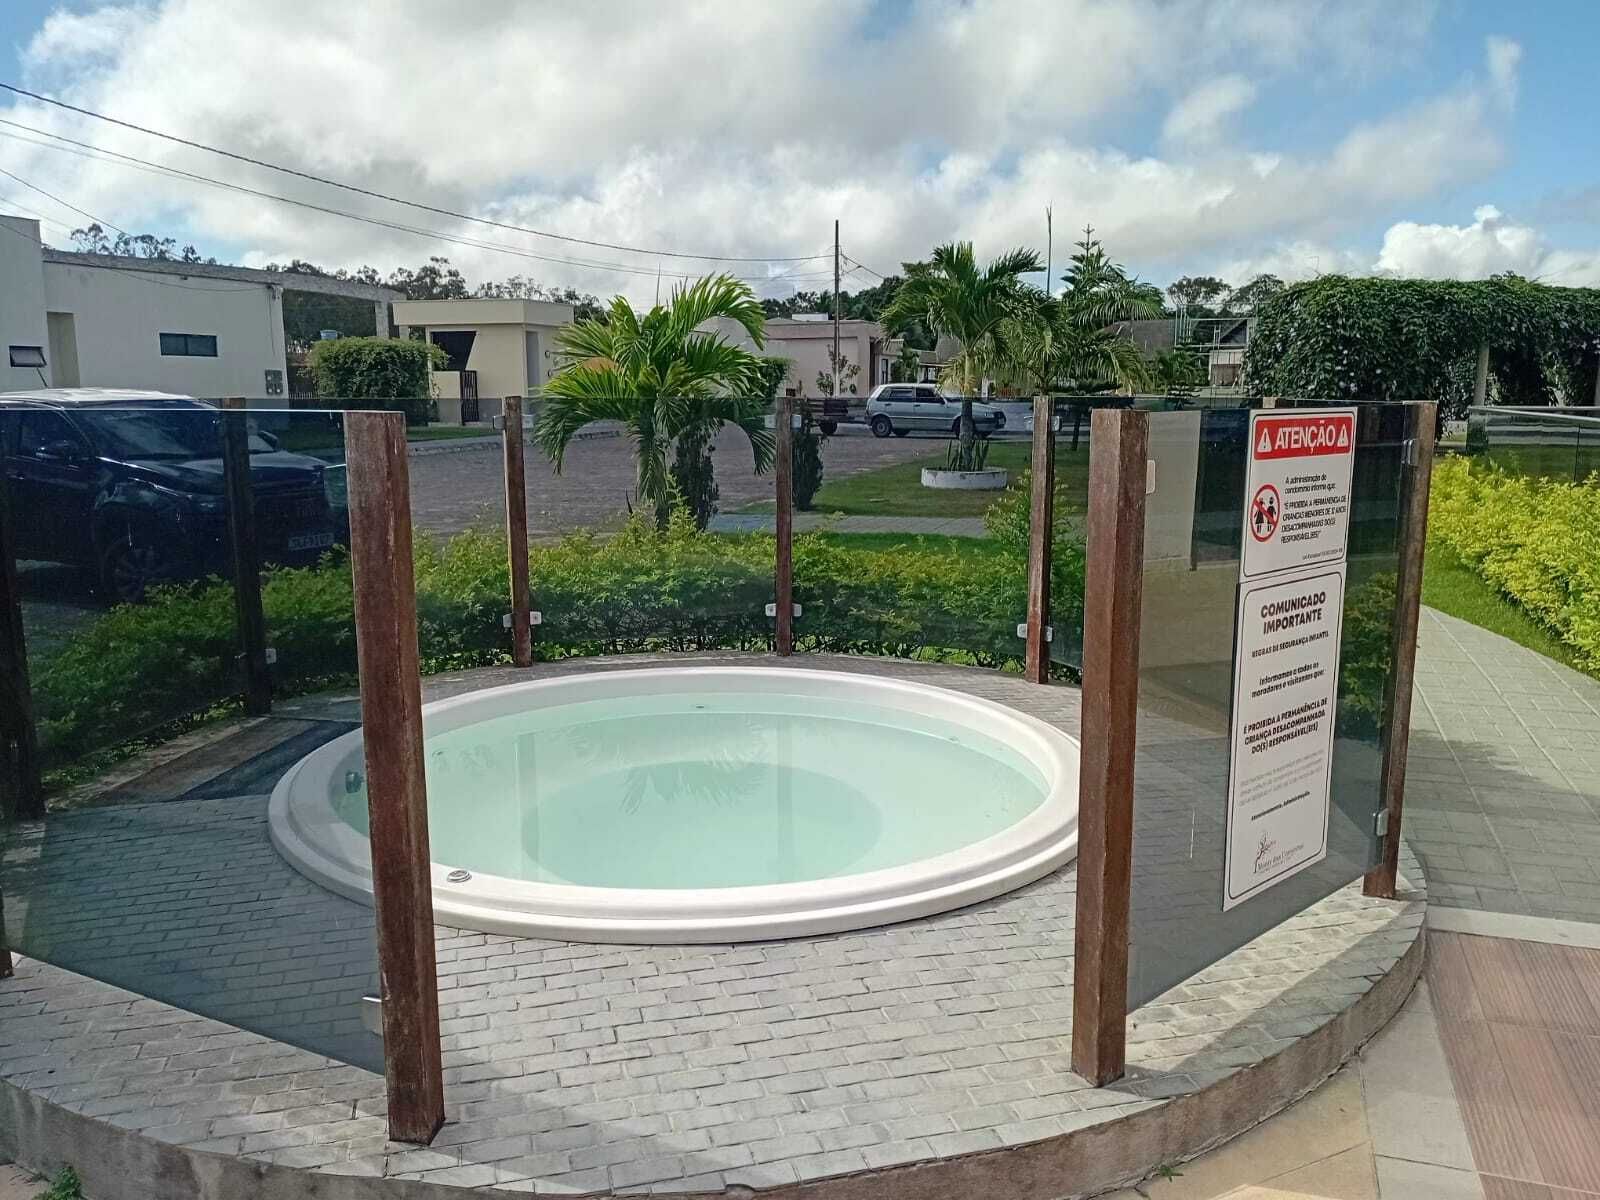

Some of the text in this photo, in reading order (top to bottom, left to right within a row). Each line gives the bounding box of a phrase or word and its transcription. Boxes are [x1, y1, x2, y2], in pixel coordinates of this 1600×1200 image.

[1274, 420, 1336, 454] ATENÇÃO
[1261, 592, 1326, 618] COMUNICADO
[1264, 608, 1322, 634] IMPORTANTE
[1280, 636, 1308, 650] SEGURANÇA
[1252, 684, 1282, 698] moradores
[1245, 708, 1326, 745] CRIANÇA DESACOMPANHADA
[1248, 716, 1276, 732] PROIBIDA
[1321, 697, 1328, 706] DE
